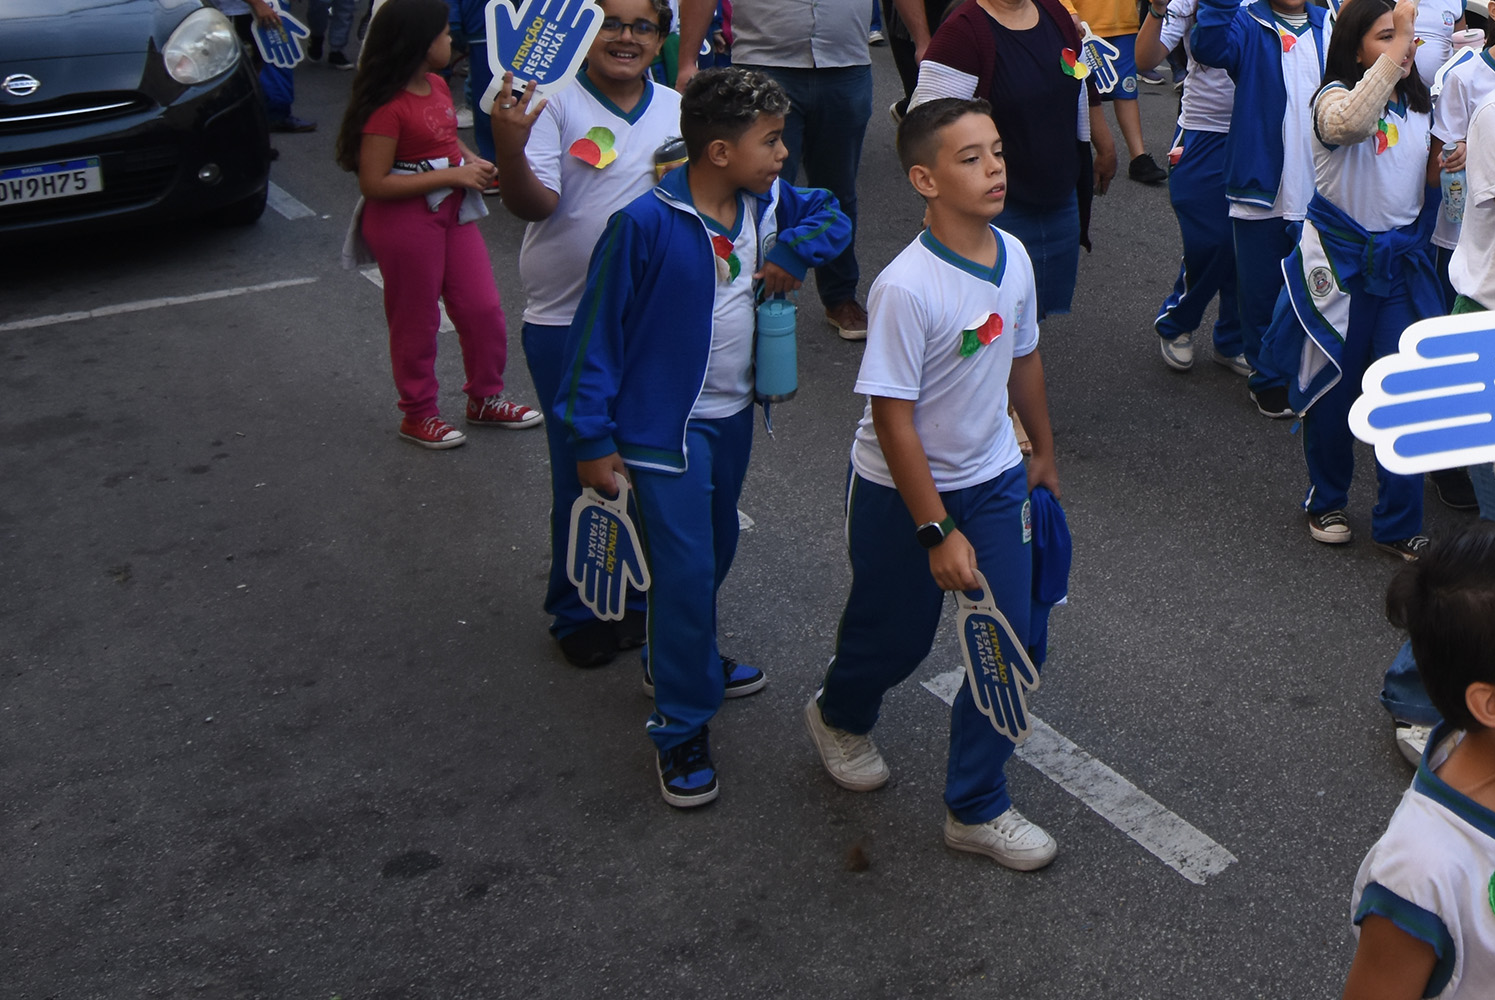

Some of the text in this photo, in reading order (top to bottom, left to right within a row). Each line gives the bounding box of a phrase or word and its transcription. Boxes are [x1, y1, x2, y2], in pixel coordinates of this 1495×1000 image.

[511, 15, 546, 71] ATENÇÃO!
[522, 21, 558, 75] RESPEITE
[534, 70, 547, 80] A
[590, 510, 599, 519] A
[595, 515, 608, 569] RESPEITE
[605, 520, 619, 574] ATENÇÃO!
[971, 620, 979, 630] A
[979, 622, 1000, 683] RESPEITE
[987, 623, 1009, 684] ATENÇÃO!
